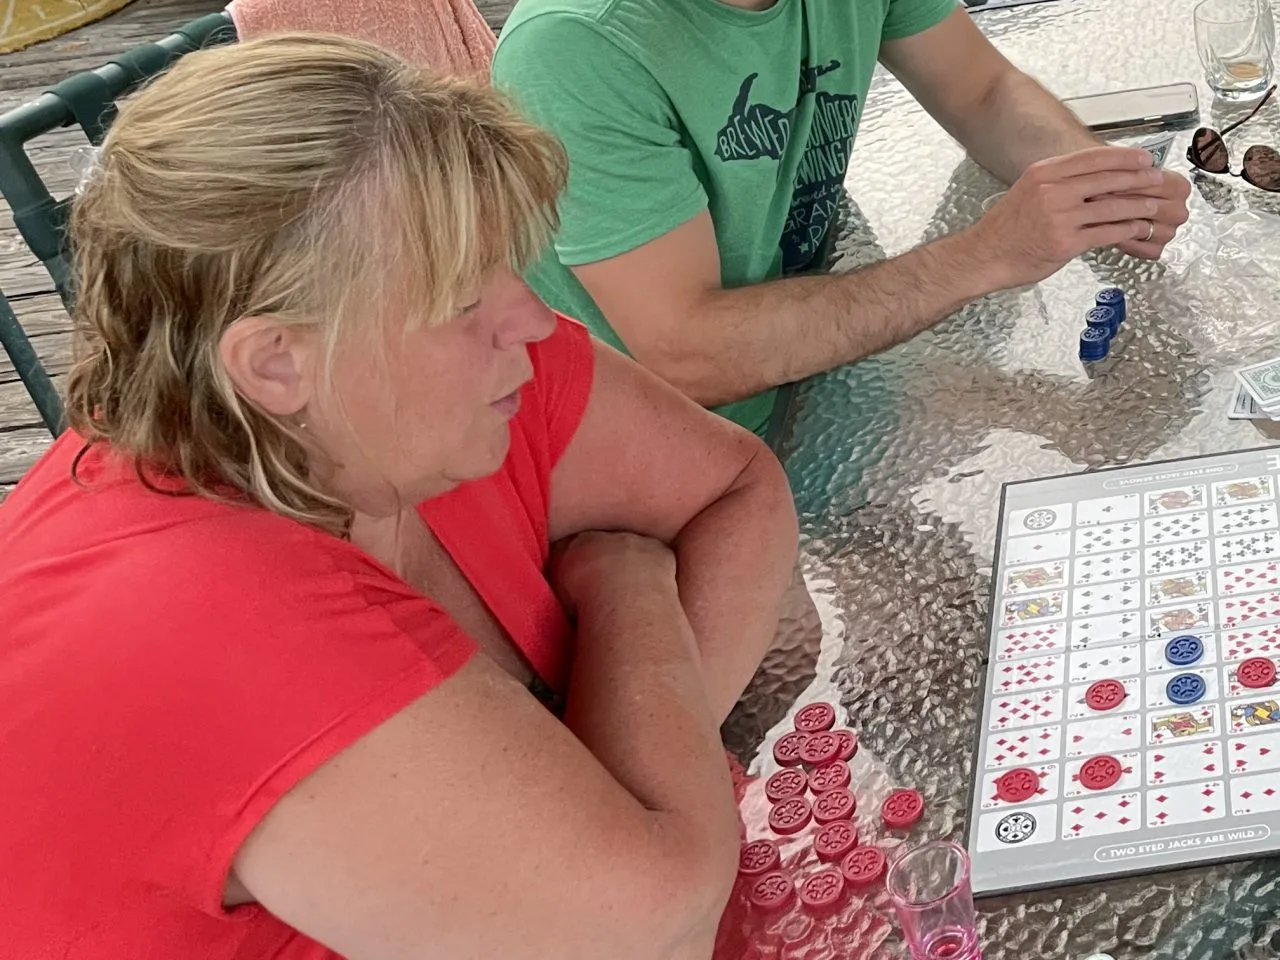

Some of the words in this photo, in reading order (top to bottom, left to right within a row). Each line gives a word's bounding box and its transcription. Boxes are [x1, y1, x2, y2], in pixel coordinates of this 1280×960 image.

[719, 108, 790, 158] BREWED
[1110, 846, 1136, 858] TWO
[1138, 842, 1164, 854] EYED
[1167, 837, 1201, 850] JACKS
[1204, 833, 1225, 844] ARE
[1227, 830, 1256, 841] WILD
